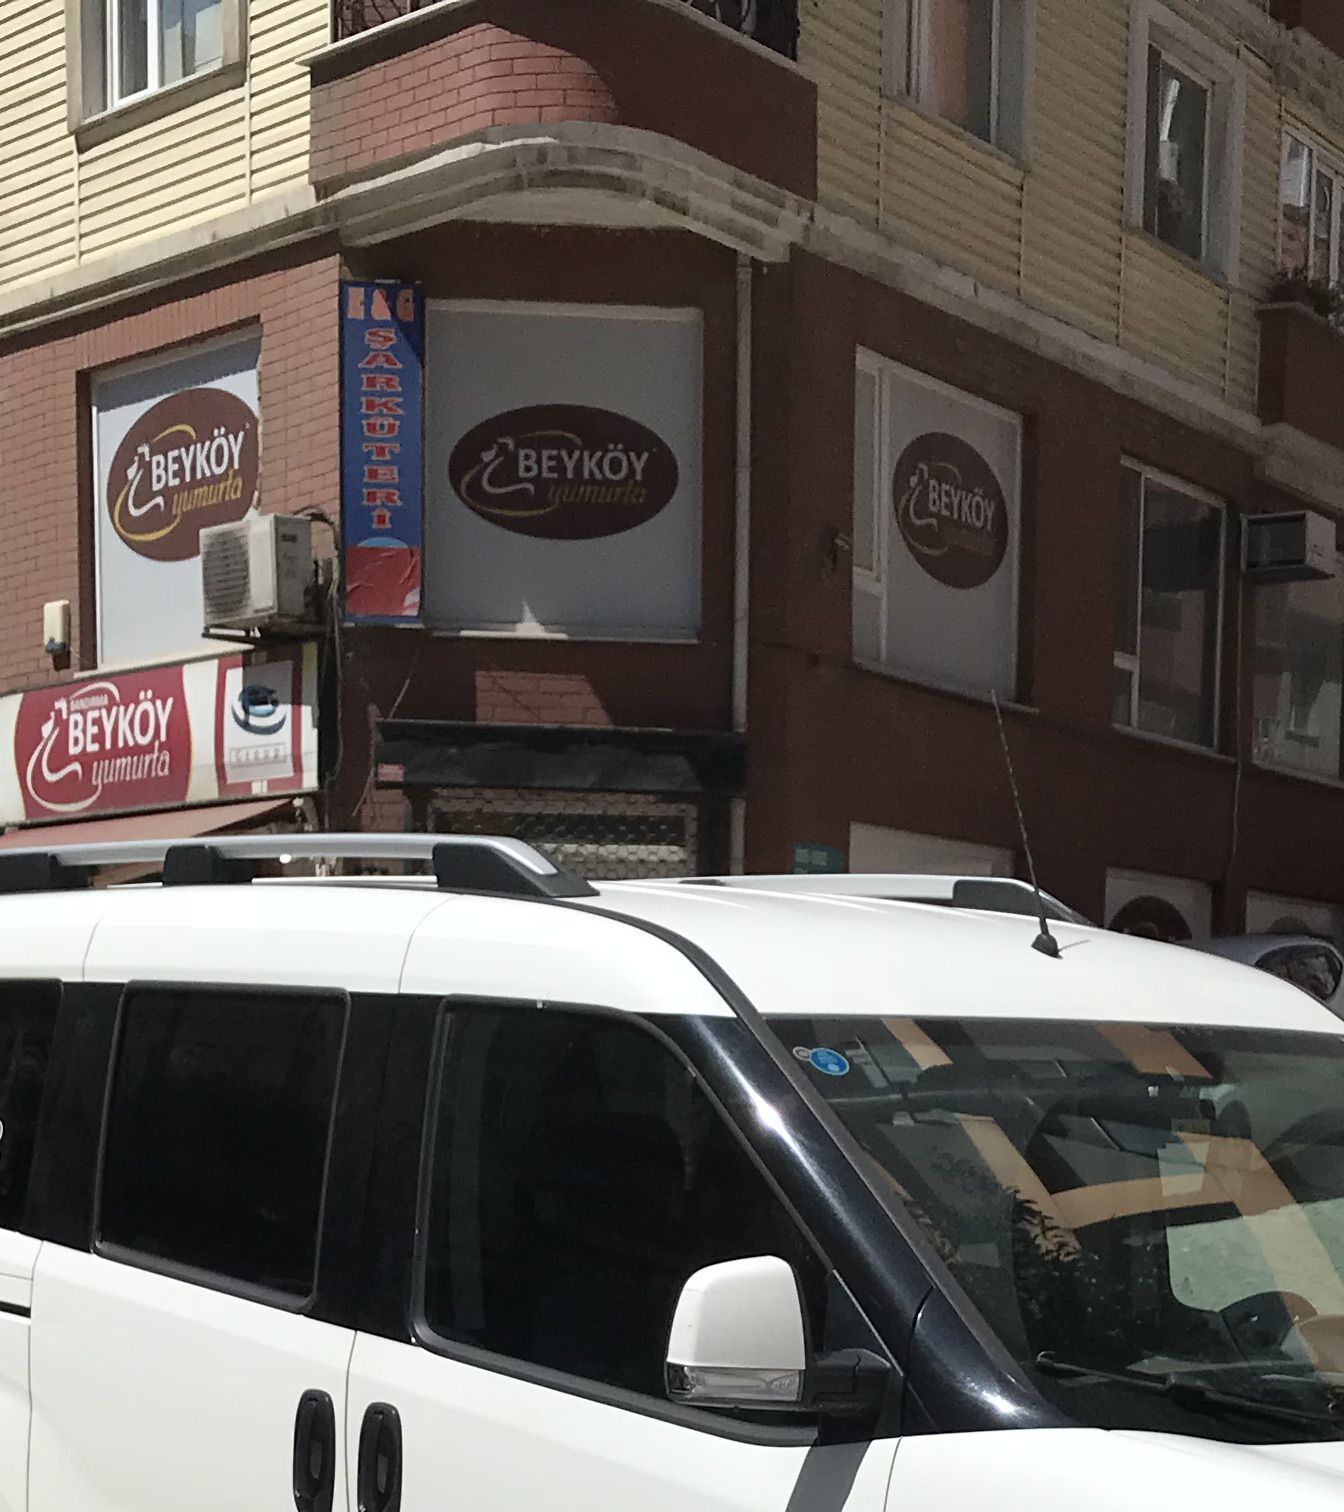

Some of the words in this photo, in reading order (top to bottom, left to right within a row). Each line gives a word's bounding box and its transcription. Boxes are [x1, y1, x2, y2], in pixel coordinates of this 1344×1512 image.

[152, 426, 245, 491] BEYKÖY
[518, 443, 649, 481] BEYKÖY
[171, 468, 243, 515] yumurta
[928, 479, 995, 532] BEYKÖY
[68, 689, 174, 755] BEYKÖY
[92, 741, 170, 786] yumurta
